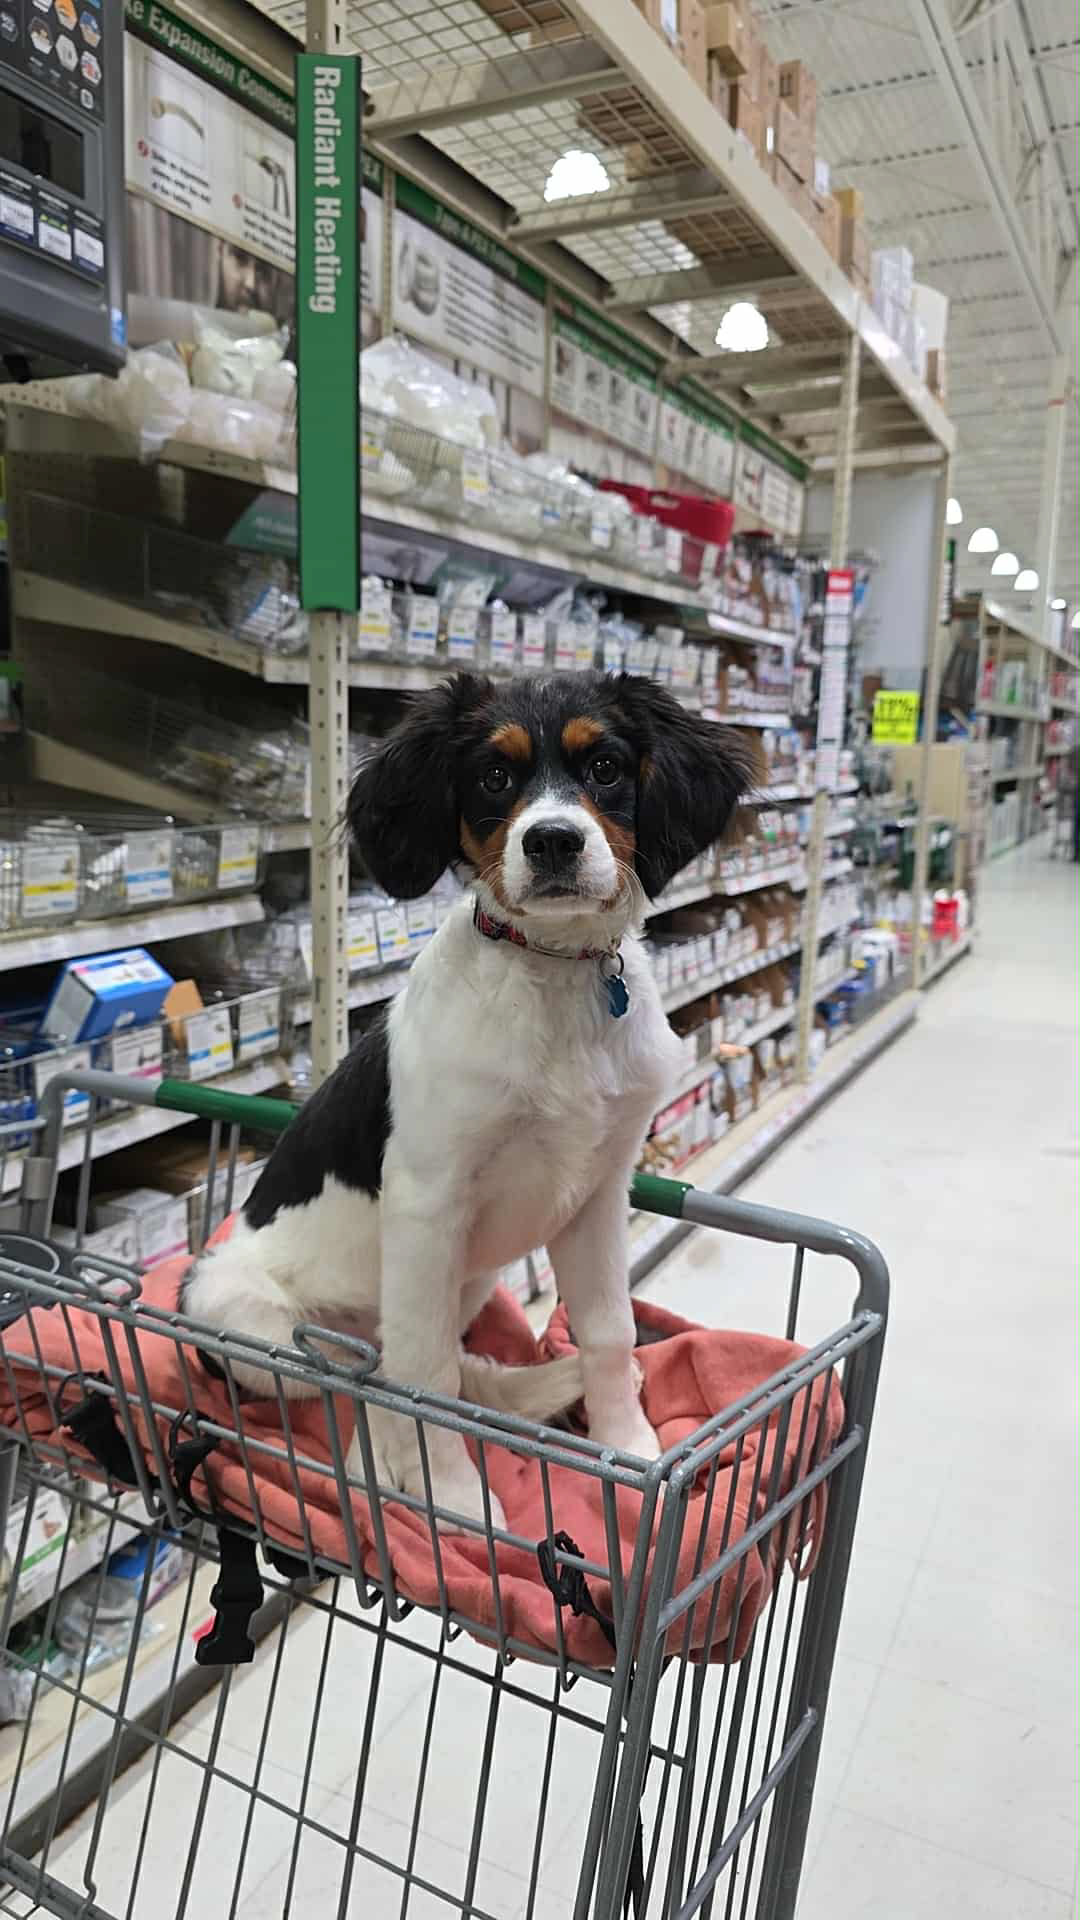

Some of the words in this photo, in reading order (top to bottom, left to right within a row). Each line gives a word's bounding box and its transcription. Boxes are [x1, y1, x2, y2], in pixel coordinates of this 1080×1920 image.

[149, 6, 234, 81] Expansion
[314, 66, 341, 187] Radiant
[308, 197, 341, 313] Heating
